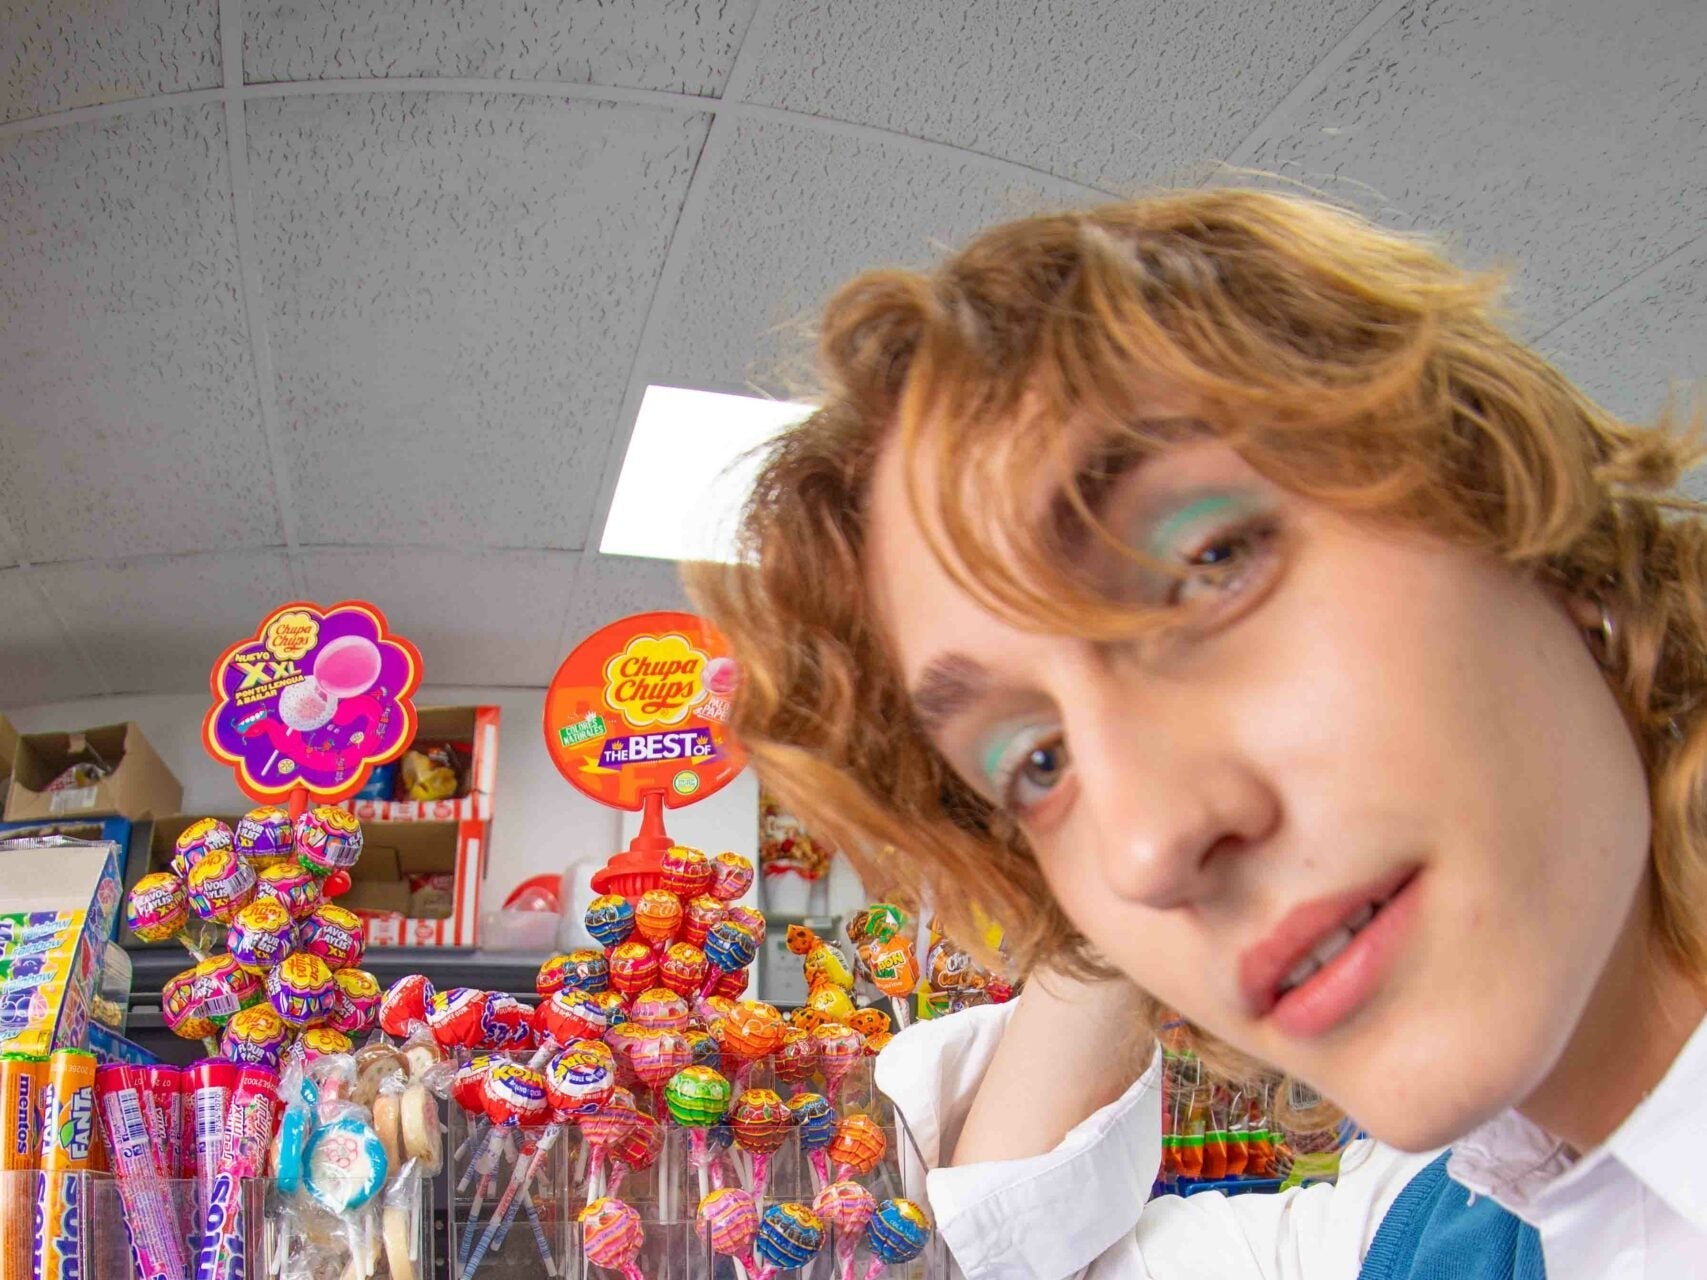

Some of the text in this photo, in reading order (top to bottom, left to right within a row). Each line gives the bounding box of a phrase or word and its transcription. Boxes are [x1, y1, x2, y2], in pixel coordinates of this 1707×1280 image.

[276, 623, 313, 635] Chupa
[272, 634, 310, 652] Chups
[235, 652, 270, 663] NUEVO
[620, 657, 699, 681] Chupa
[231, 660, 302, 691] XXL
[243, 690, 277, 704] BAILAR
[615, 678, 694, 714] Chups
[563, 727, 604, 745] NATURALES
[566, 719, 598, 737] COLORES
[604, 733, 711, 762] THE BEST OF
[17, 1073, 30, 1155] mentos
[70, 1086, 94, 1160] FANTA
[232, 1104, 245, 1137] mix
